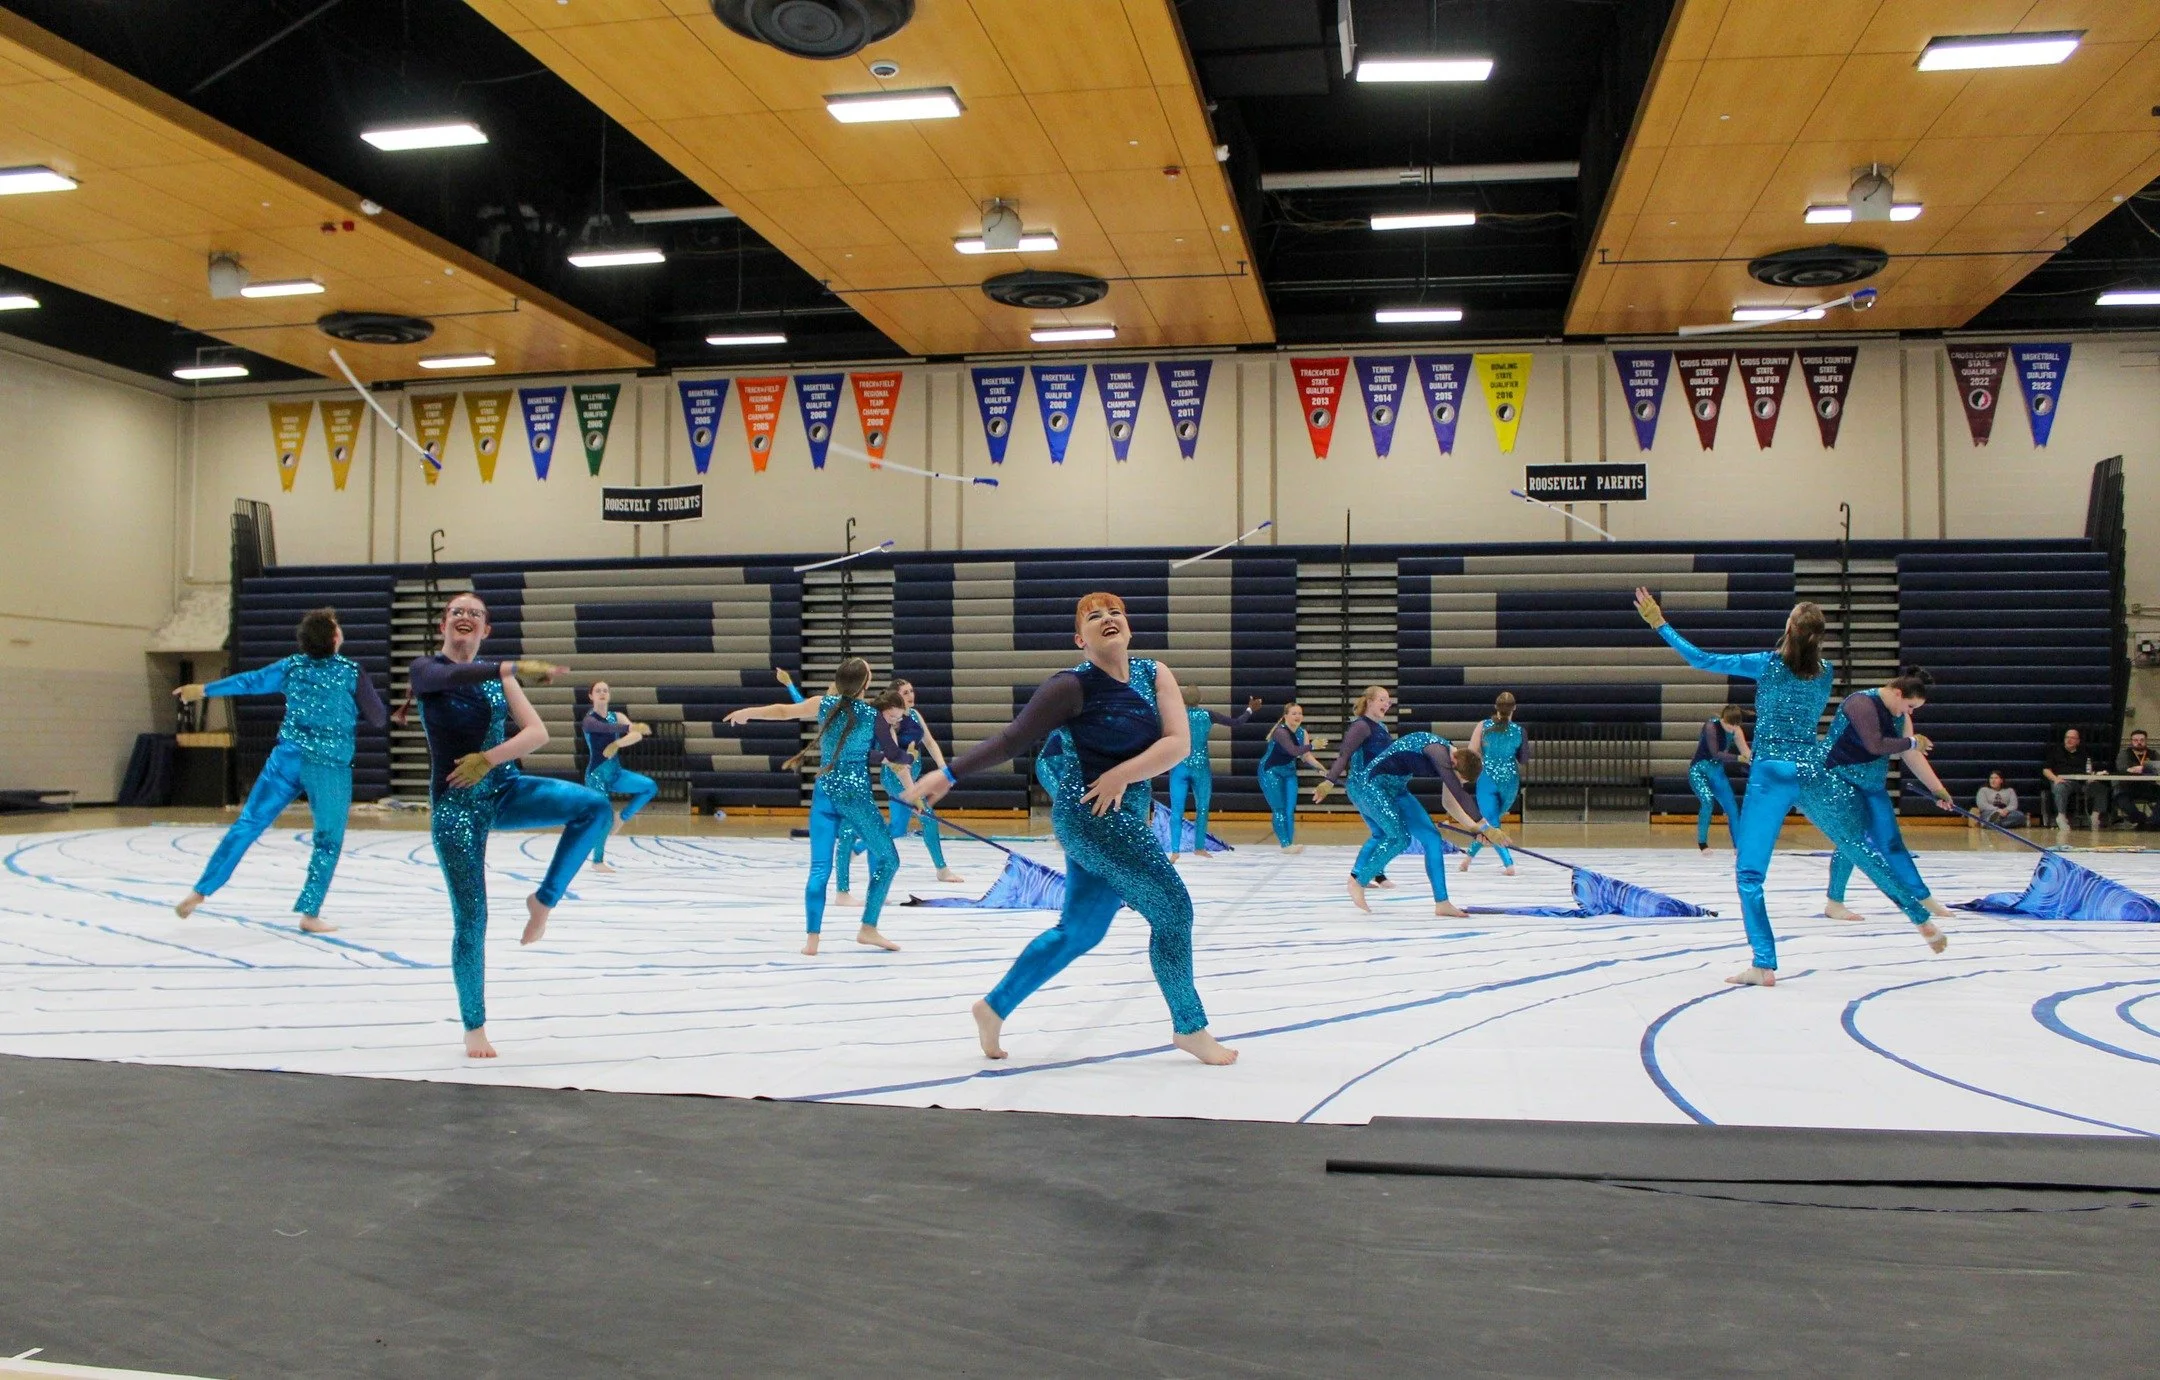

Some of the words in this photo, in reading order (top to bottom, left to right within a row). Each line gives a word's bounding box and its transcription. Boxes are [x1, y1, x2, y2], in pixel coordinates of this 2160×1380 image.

[1803, 357, 1823, 365] CROSS
[1824, 356, 1852, 364] COUNTRY
[2022, 353, 2059, 361] BASKETBALL
[1491, 362, 1518, 370] BOWLING
[1632, 360, 1654, 368] TENNIS
[1680, 359, 1700, 367] CROSS
[1701, 358, 1728, 367] COUNTRY
[1740, 358, 1760, 367] CROSS
[1762, 357, 1789, 366] COUNTRY
[2032, 362, 2050, 370] STATE
[1301, 368, 1340, 376] TRACK&FIELD
[1372, 366, 1394, 374] TENNIS
[1432, 364, 1454, 372] TENNIS
[1695, 368, 1713, 376] STATE
[1756, 367, 1773, 375] STATE
[1819, 366, 1837, 374] STATE
[1961, 368, 1997, 376] QUALIFIER
[1174, 370, 1195, 378] TENNIS
[1435, 373, 1451, 381] STATE
[1495, 372, 1512, 380] STATE
[1635, 369, 1652, 377] STATE
[2027, 371, 2057, 379] QUALIFIER
[981, 377, 1014, 385] BASKETBALL
[1042, 374, 1075, 382] BASKETBALL
[1311, 378, 1328, 386] STATE
[1374, 375, 1391, 383] STATE
[1629, 378, 1658, 386] QUALIFIER
[1690, 377, 1719, 386] QUALIFIER
[1750, 376, 1779, 384] QUALIFIER
[1813, 375, 1843, 383] QUALIFIER
[803, 383, 835, 391] BASKETBALL
[1051, 382, 1066, 390] STATE
[1107, 381, 1134, 389] REGIONAL
[1171, 380, 1198, 388] REGIONAL
[1369, 383, 1397, 391] QUALIFIER
[1429, 381, 1458, 390] QUALIFIER
[2032, 382, 2052, 390] 2022
[688, 389, 718, 397] BASKETBALL
[1178, 389, 1193, 397] TEAM
[1306, 387, 1334, 395] QUALIFIER
[1635, 388, 1654, 397] 2016
[1696, 388, 1713, 396] 2017
[1756, 386, 1774, 395] 2018
[1819, 385, 1838, 394] 2021
[811, 392, 826, 400] STATE
[864, 390, 889, 398] REGIONAL
[1045, 391, 1072, 400] QUALIFIER
[1114, 391, 1129, 399] TEAM
[1374, 394, 1391, 402] 2014
[1435, 392, 1452, 400] 2015
[1496, 391, 1513, 399] 2016
[527, 396, 556, 405] BASKETBALL
[696, 398, 710, 406] STATE
[984, 396, 1011, 404] QUALIFIER
[1171, 398, 1200, 406] CHAMPION
[1312, 397, 1329, 406] 2013
[535, 405, 549, 413] STATE
[588, 402, 602, 410] STATE
[806, 401, 831, 409] QUALIFIER
[583, 410, 607, 418] QUALIFIER
[691, 406, 715, 415] QUALIFIER
[990, 406, 1007, 414] 2007
[1178, 409, 1194, 417] 2011
[530, 413, 554, 421] QUALIFIER
[748, 412, 774, 420] CHAMPION
[695, 416, 710, 425] 2005
[1529, 476, 1587, 490] ROOSEVELT
[1597, 475, 1643, 490] PARENTS
[605, 498, 651, 512] ROOSEVELT
[657, 495, 700, 512] STUDENTS
